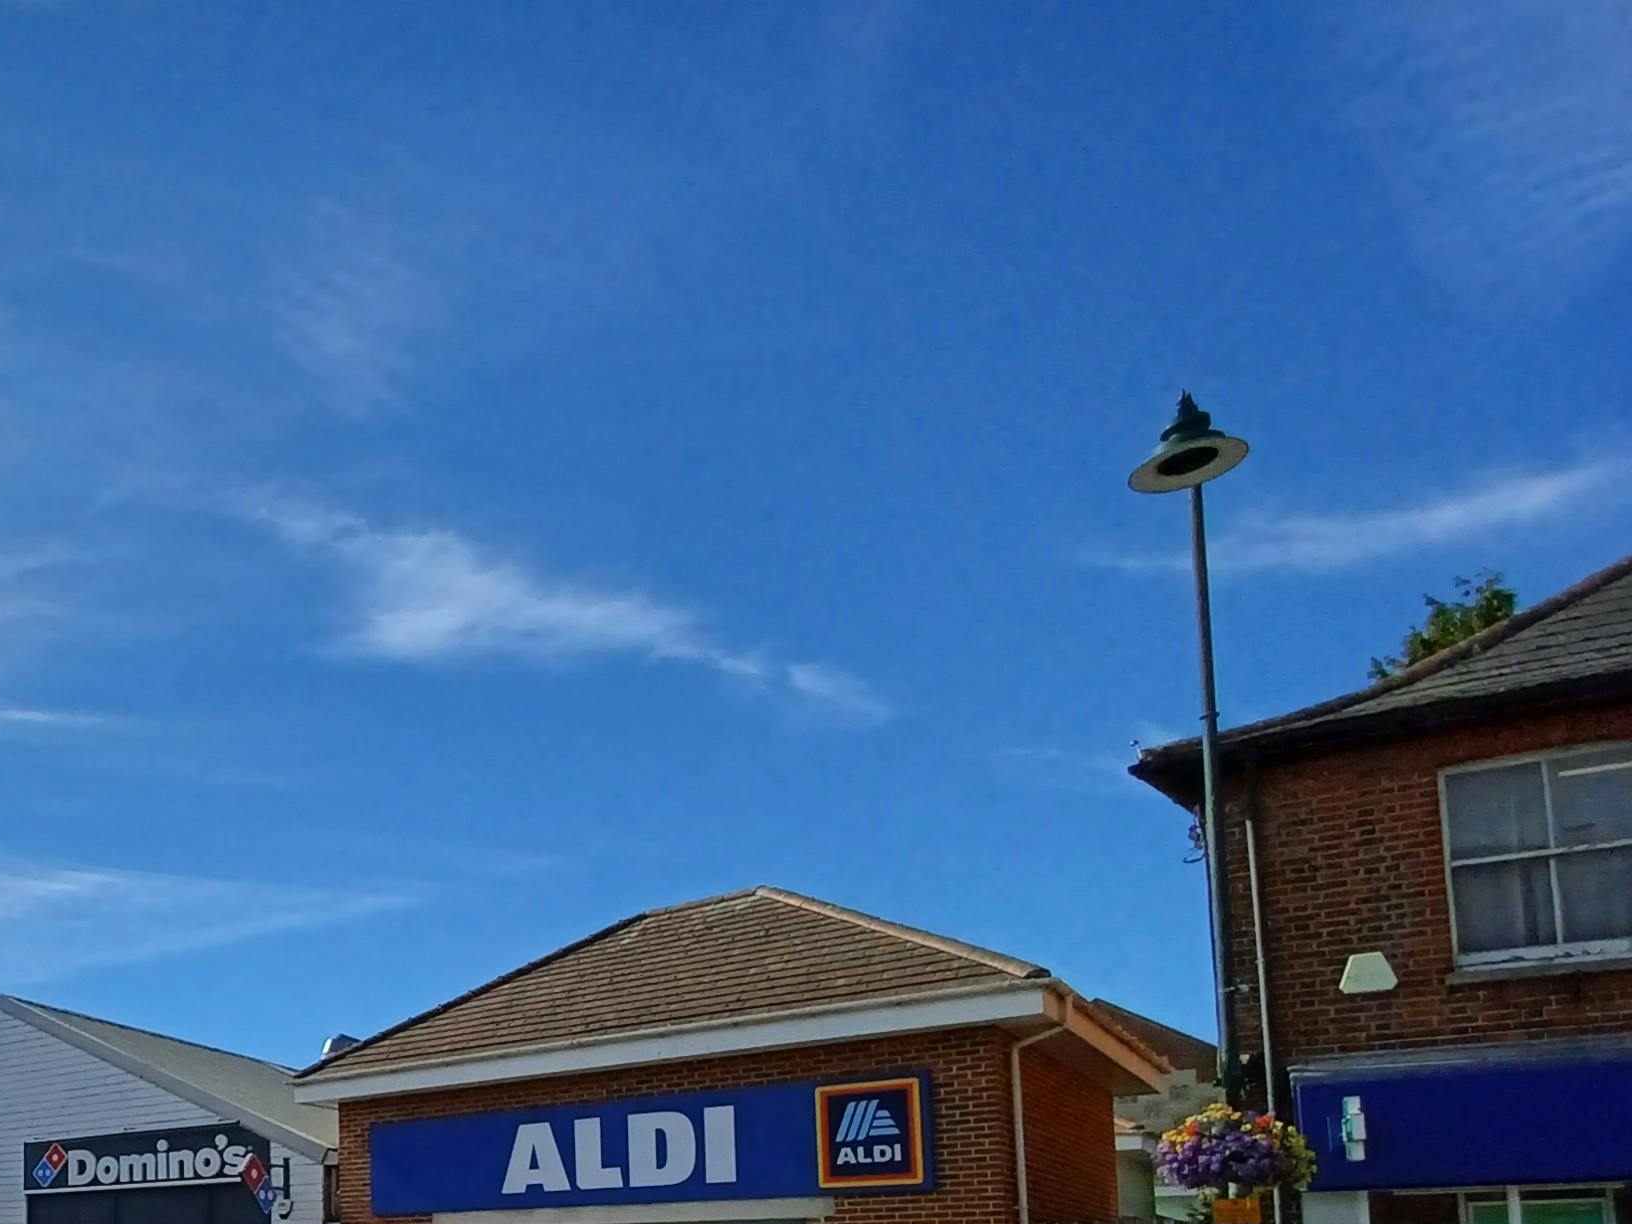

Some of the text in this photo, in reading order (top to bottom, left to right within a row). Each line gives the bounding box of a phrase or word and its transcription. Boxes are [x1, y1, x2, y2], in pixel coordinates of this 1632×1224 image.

[67, 1134, 248, 1186] Domino's
[501, 1105, 737, 1194] ALDI
[836, 1143, 903, 1165] ALDI
